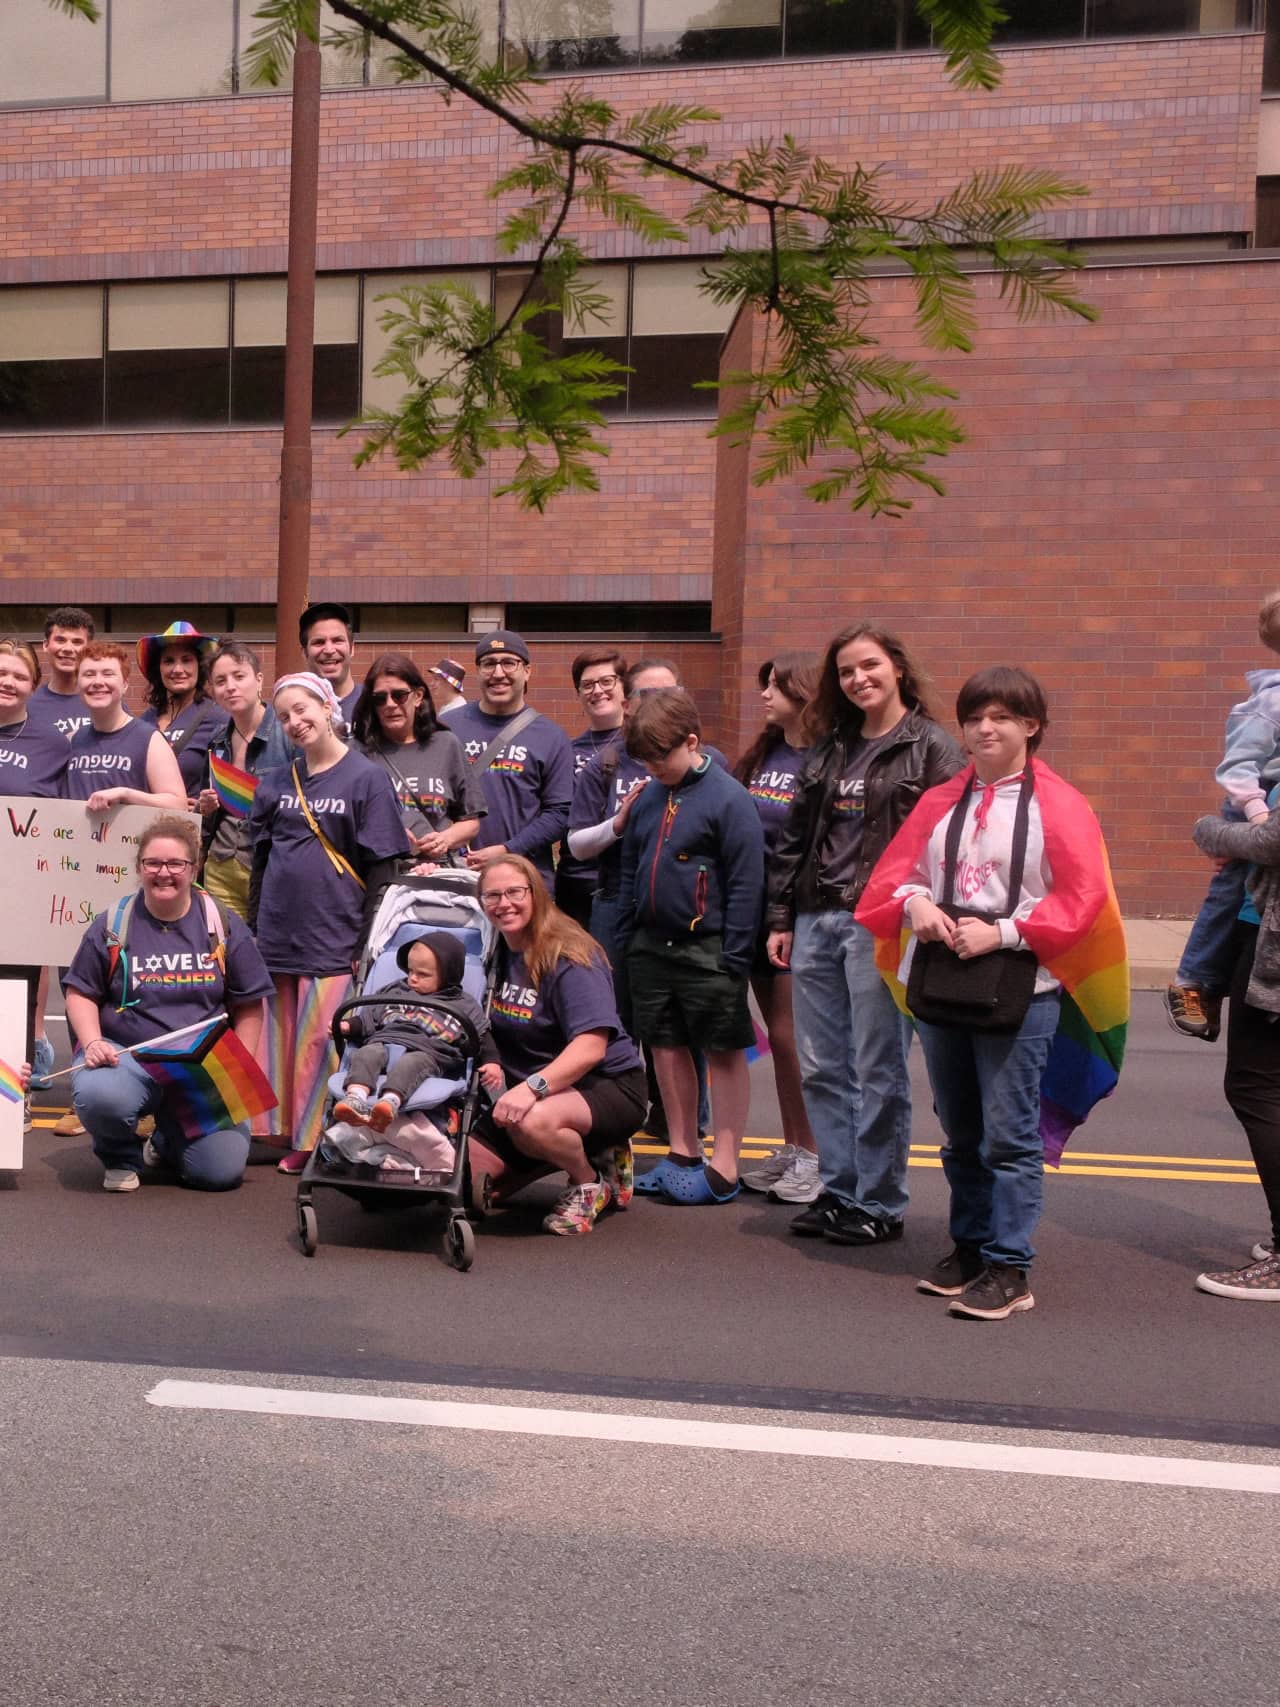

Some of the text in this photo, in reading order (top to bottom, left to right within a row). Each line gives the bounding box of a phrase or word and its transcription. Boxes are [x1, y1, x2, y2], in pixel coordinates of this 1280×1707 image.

[69, 755, 131, 771] משפחה
[429, 778, 445, 794] IS
[7, 807, 139, 845] We are all ma
[37, 854, 128, 883] in the image
